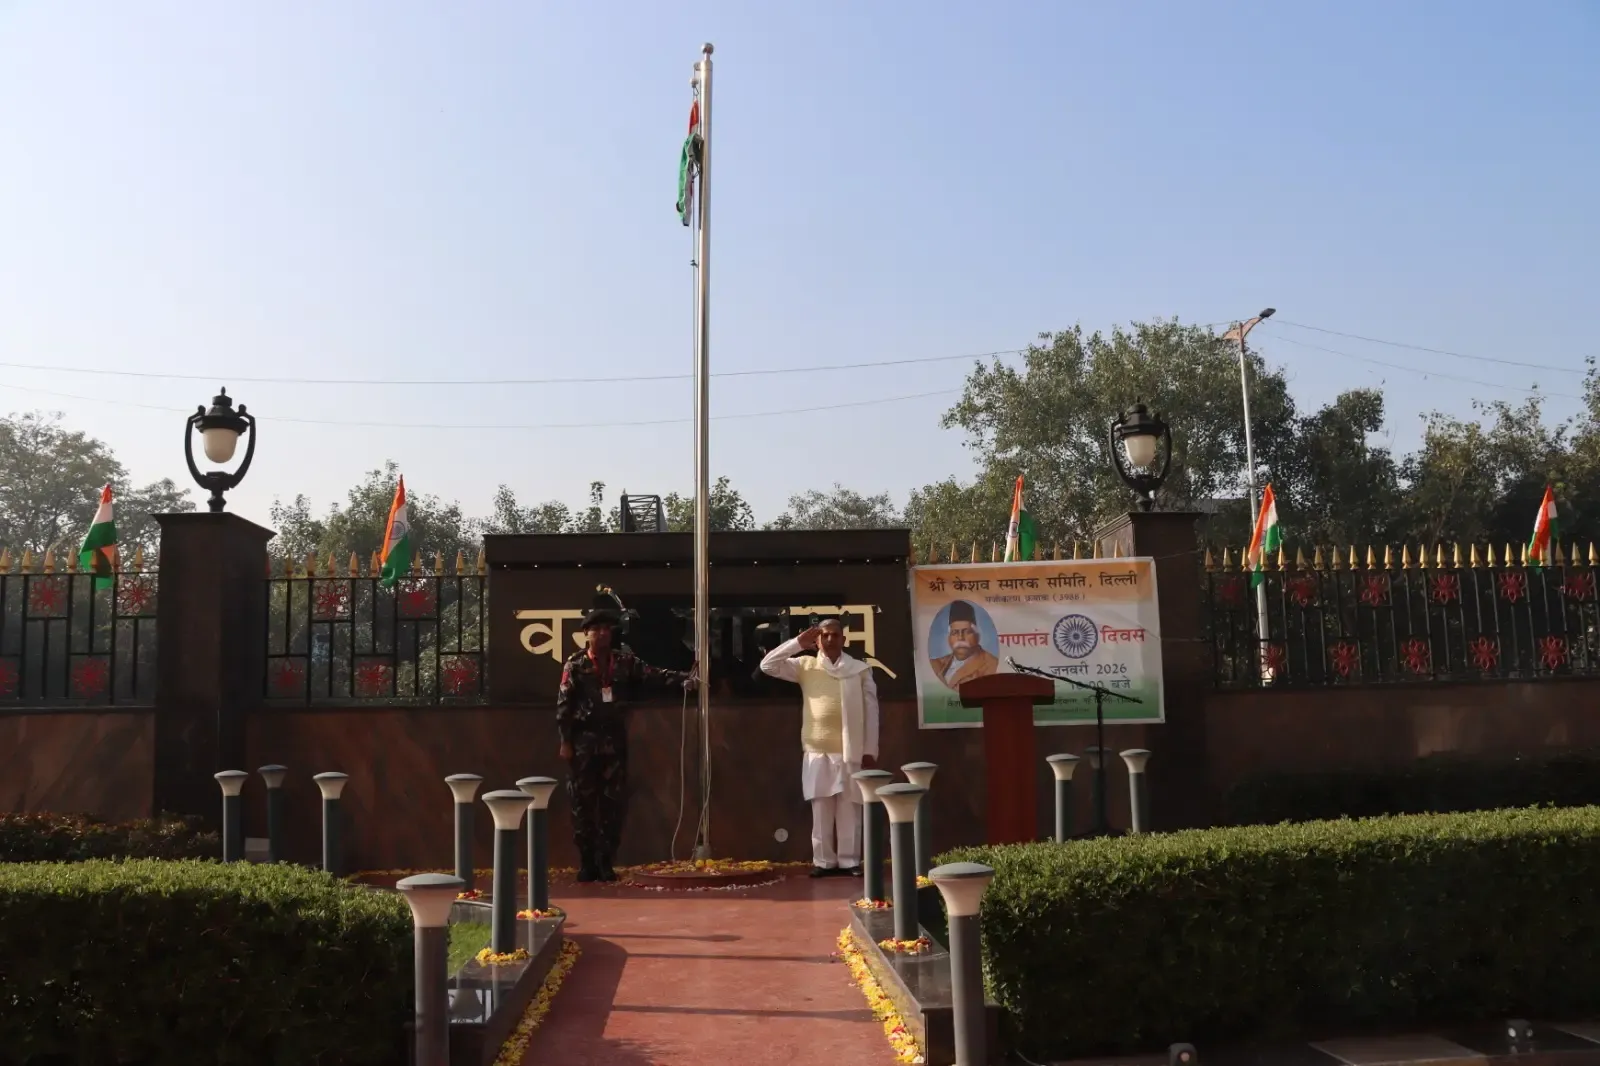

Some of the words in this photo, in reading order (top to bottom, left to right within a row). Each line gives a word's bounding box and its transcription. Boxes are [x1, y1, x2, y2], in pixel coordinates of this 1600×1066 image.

[928, 577, 948, 592] श्री
[953, 576, 990, 591] केशव
[997, 577, 1039, 590] स्मारक
[1099, 569, 1138, 587] दिल्ली
[997, 627, 1049, 648] गणतंत्र
[1100, 624, 1146, 644] दिवस
[1050, 660, 1089, 676] जनवरी
[1096, 663, 1127, 675] 2026
[1110, 675, 1132, 690] बजे
